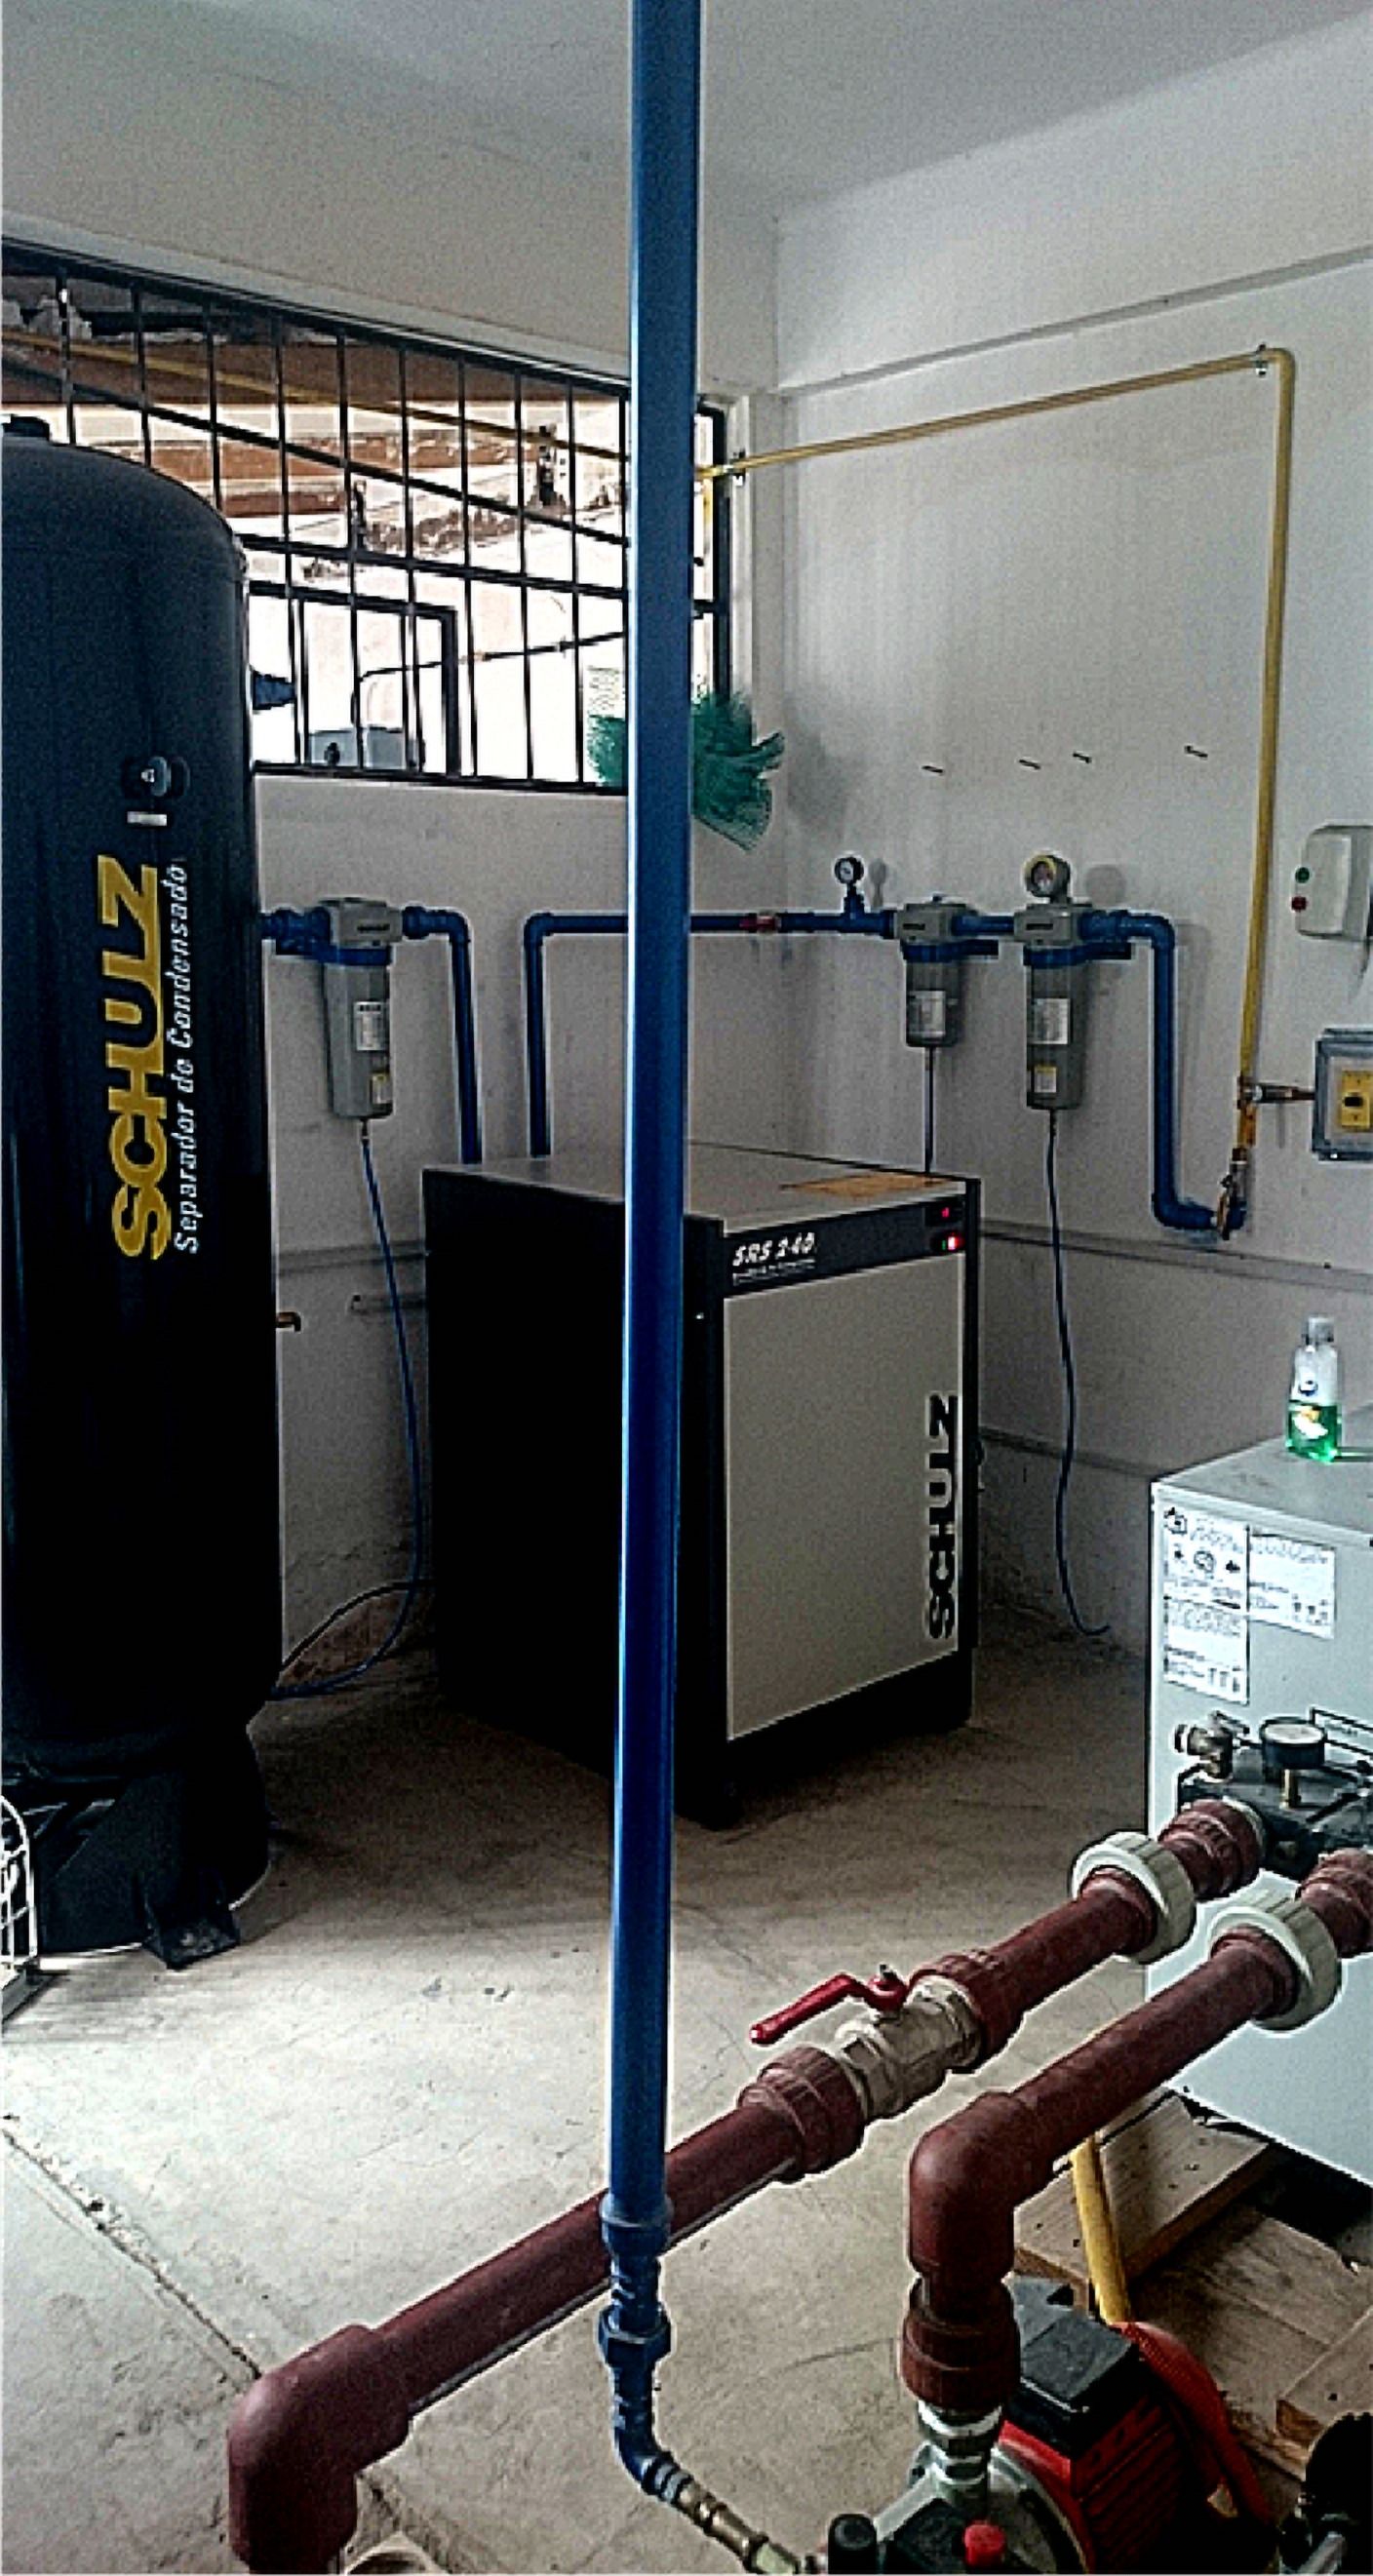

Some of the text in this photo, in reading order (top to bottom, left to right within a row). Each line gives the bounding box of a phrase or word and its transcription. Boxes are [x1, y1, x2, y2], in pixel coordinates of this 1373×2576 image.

[98, 855, 170, 1260] SCHULZ
[161, 864, 203, 1254] Separador de Condensado
[732, 1240, 773, 1267] SRS
[929, 1395, 959, 1639] SCHULZ
